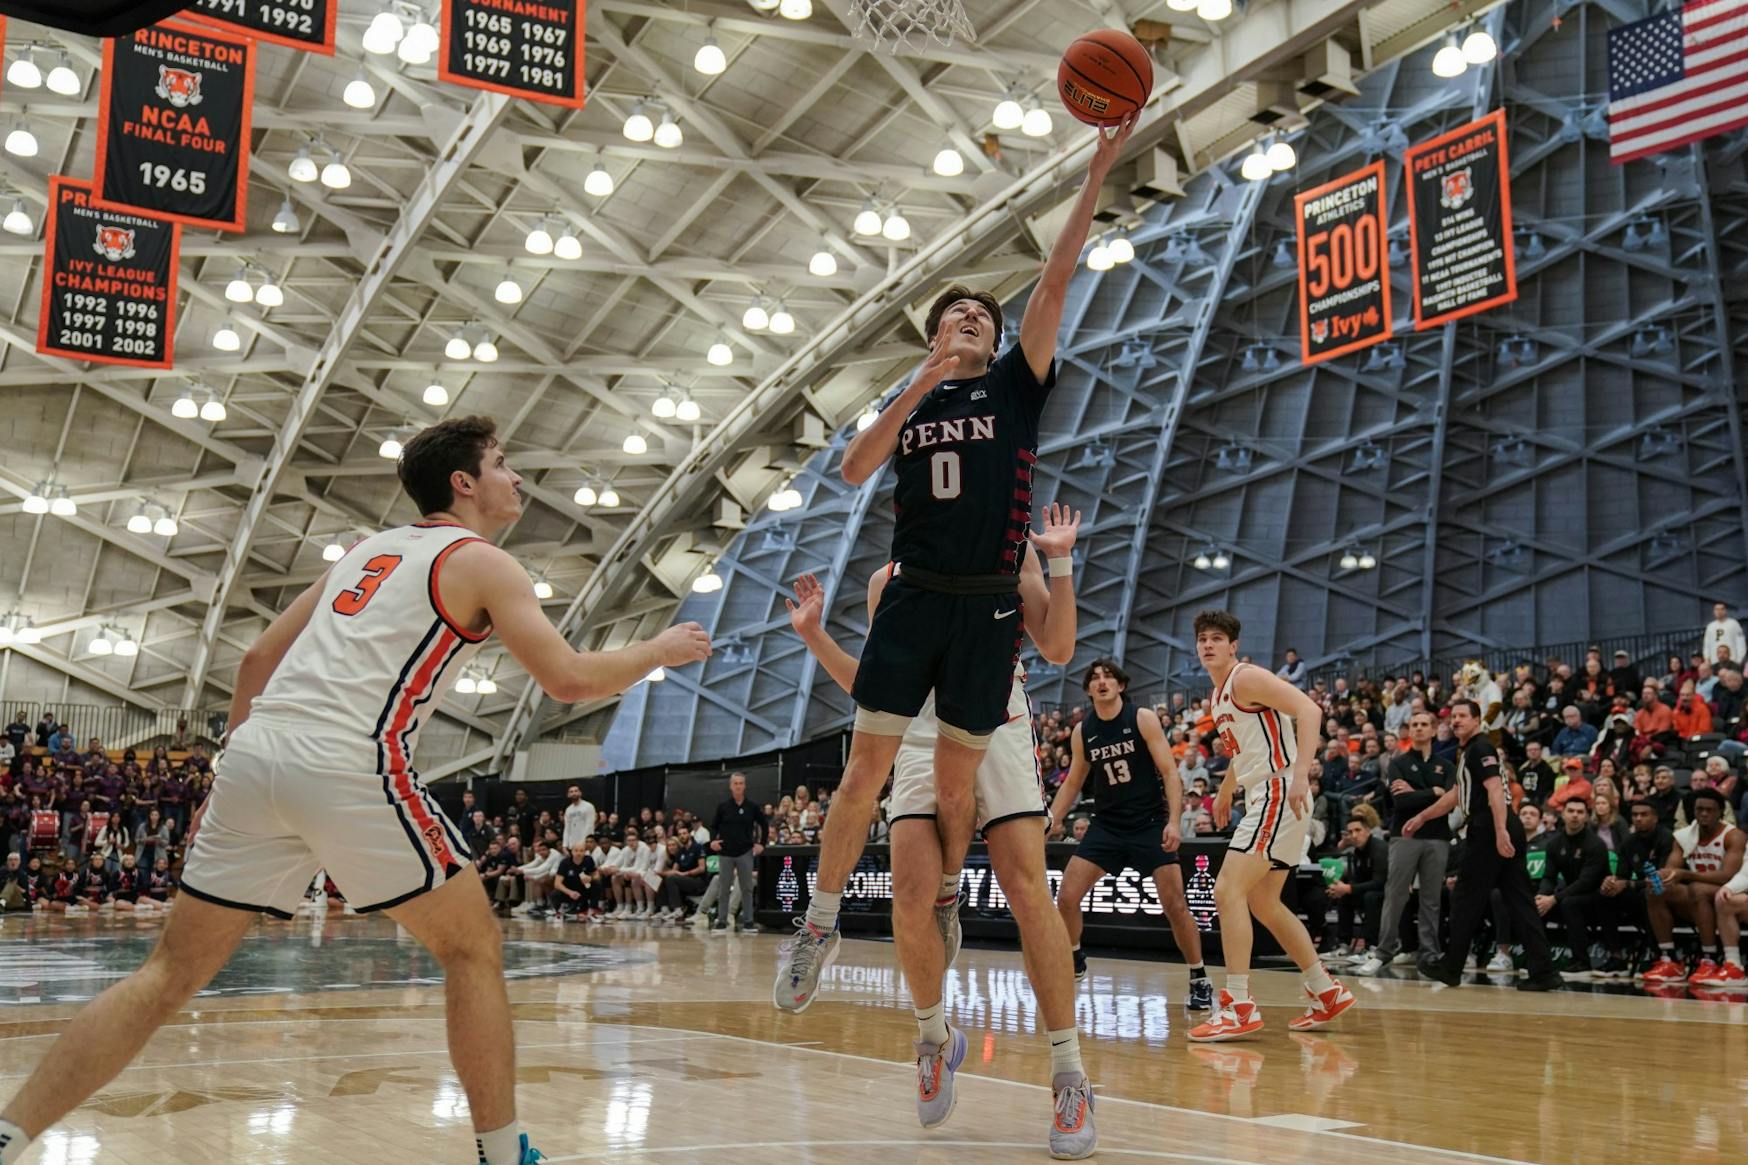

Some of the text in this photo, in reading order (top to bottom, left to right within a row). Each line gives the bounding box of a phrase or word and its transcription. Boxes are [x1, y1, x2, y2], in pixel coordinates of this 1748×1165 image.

[259, 4, 312, 33] 1992
[464, 9, 567, 46] 1965 1967
[133, 43, 228, 73] MEN'S BASKETBALL
[134, 28, 243, 65] RINCETON
[464, 30, 566, 68] 1969 1976
[463, 52, 563, 90] 1977 1981
[142, 104, 211, 137] NCAA
[123, 120, 226, 155] FINAL FOUR
[1414, 128, 1496, 173] PETE CARRIL
[139, 161, 207, 195] 1965
[1303, 175, 1378, 220] PRINCETON
[1316, 197, 1366, 226] ATHLETICS
[73, 207, 159, 229] MEN'S BASKETBALL
[1455, 216, 1484, 235] LEAGUE
[1306, 213, 1379, 299] 500
[1430, 227, 1489, 257] CHAMPIONSHIPS
[1456, 238, 1496, 260] CHAMPION
[55, 271, 167, 301] CHAMPIONS
[69, 259, 156, 283] IVY LEAGUE
[63, 292, 158, 320] 1992 1996
[1308, 279, 1380, 316] CHAMPIONSHIPS
[62, 311, 157, 338] 1997 1998
[1330, 312, 1362, 338] Ivy
[60, 329, 155, 355] 2001 2002
[901, 415, 996, 456] PENN
[931, 451, 962, 500] 0
[331, 553, 403, 617] 3
[1090, 739, 1135, 762] PENN
[1103, 759, 1132, 786] 13
[806, 871, 894, 899] WCOME
